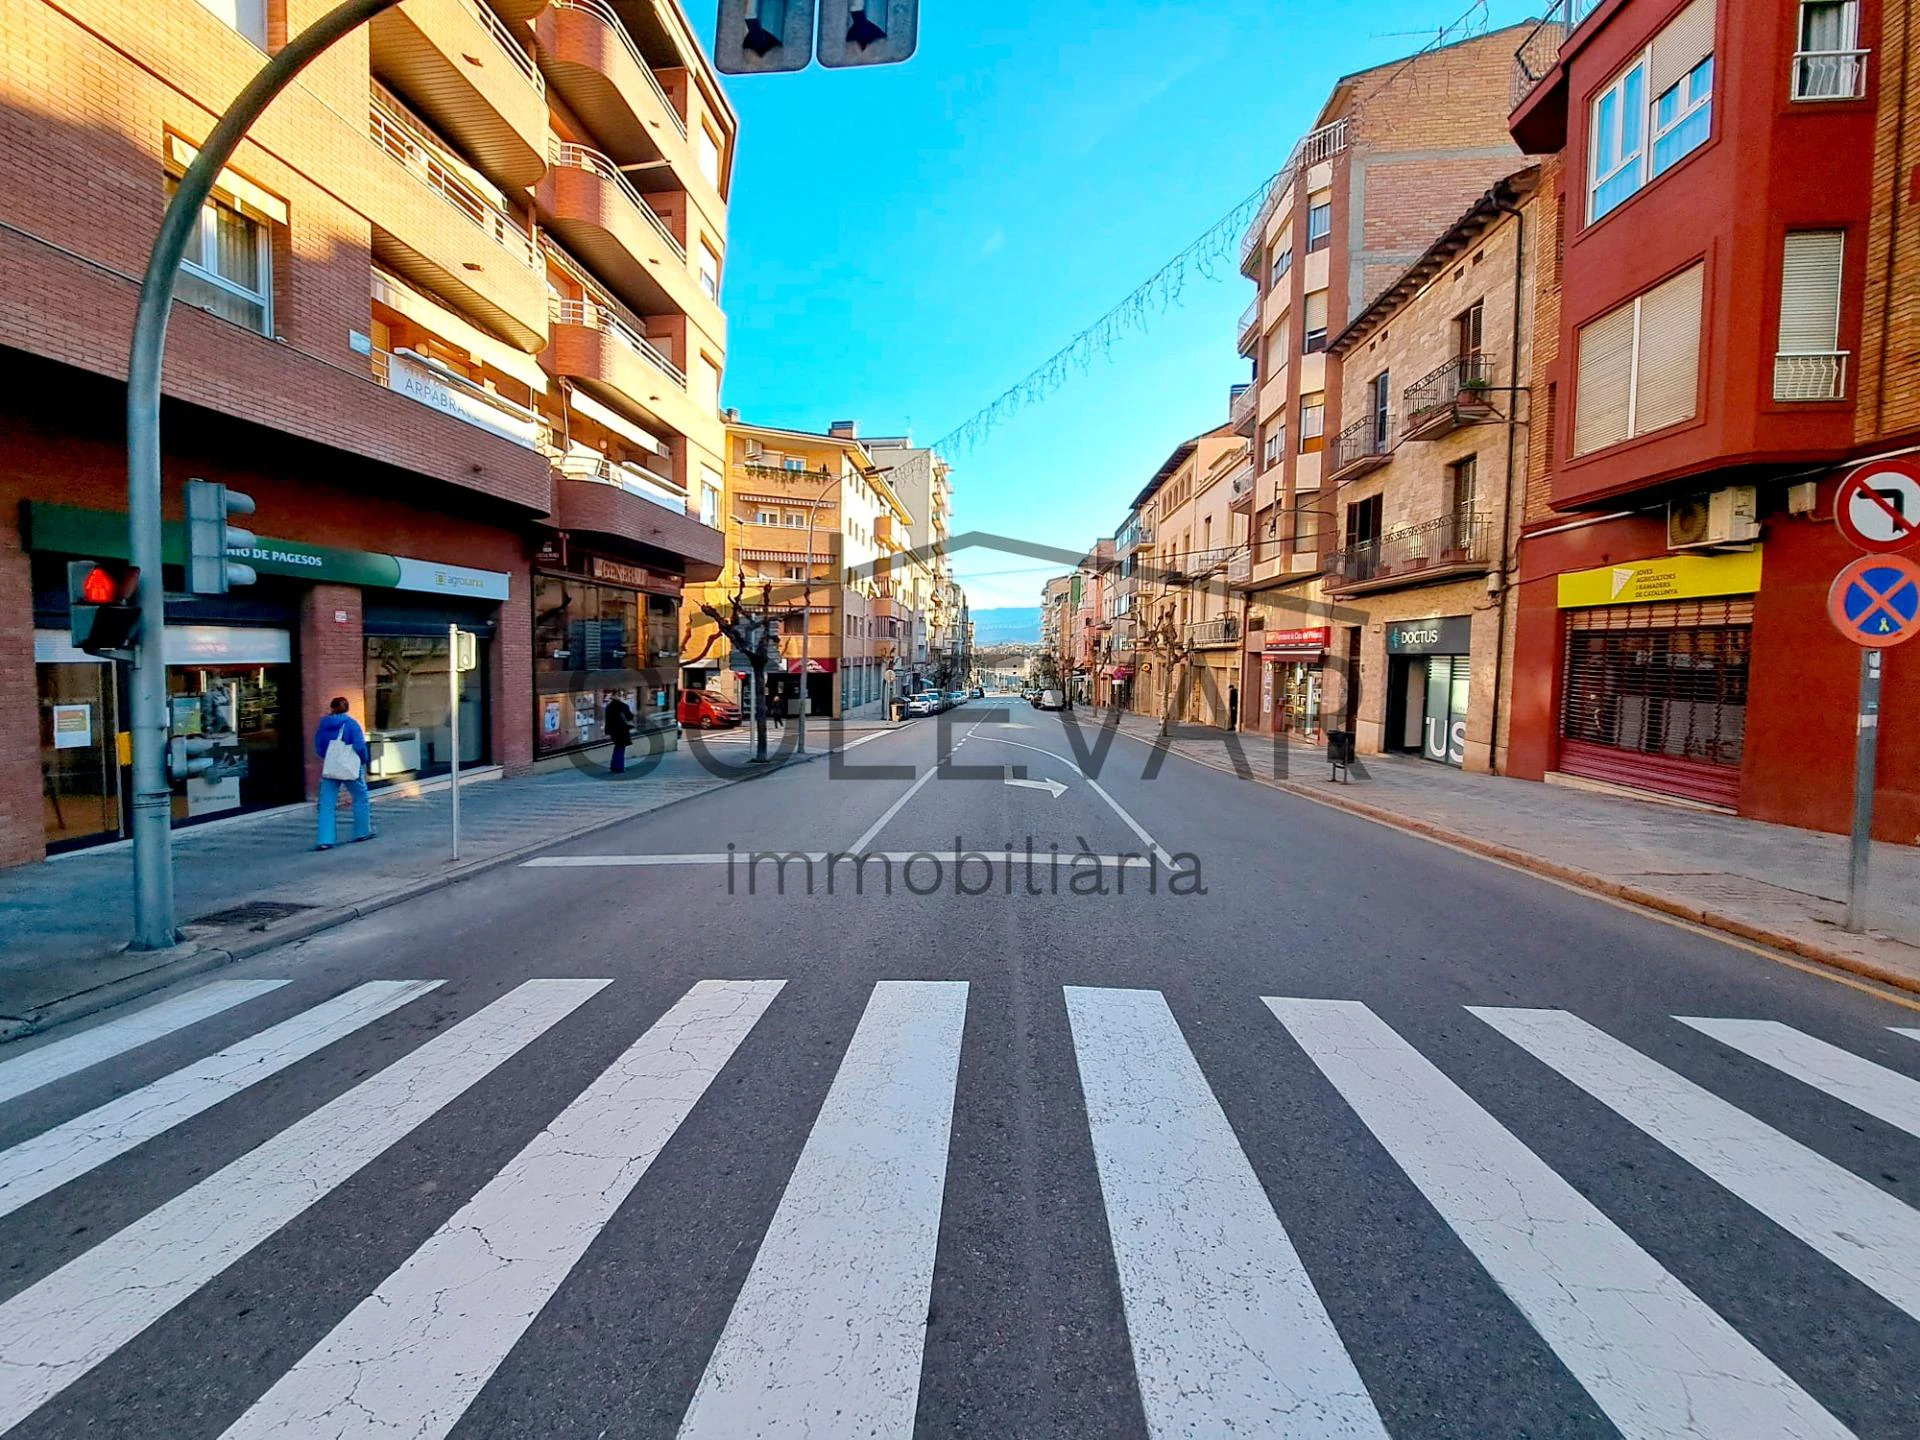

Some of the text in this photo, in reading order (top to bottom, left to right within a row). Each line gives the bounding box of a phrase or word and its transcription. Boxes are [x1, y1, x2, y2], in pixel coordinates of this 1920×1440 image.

[252, 548, 270, 560] DE
[272, 551, 322, 566] PAGESOS
[1401, 629, 1438, 644] DOCTUS
